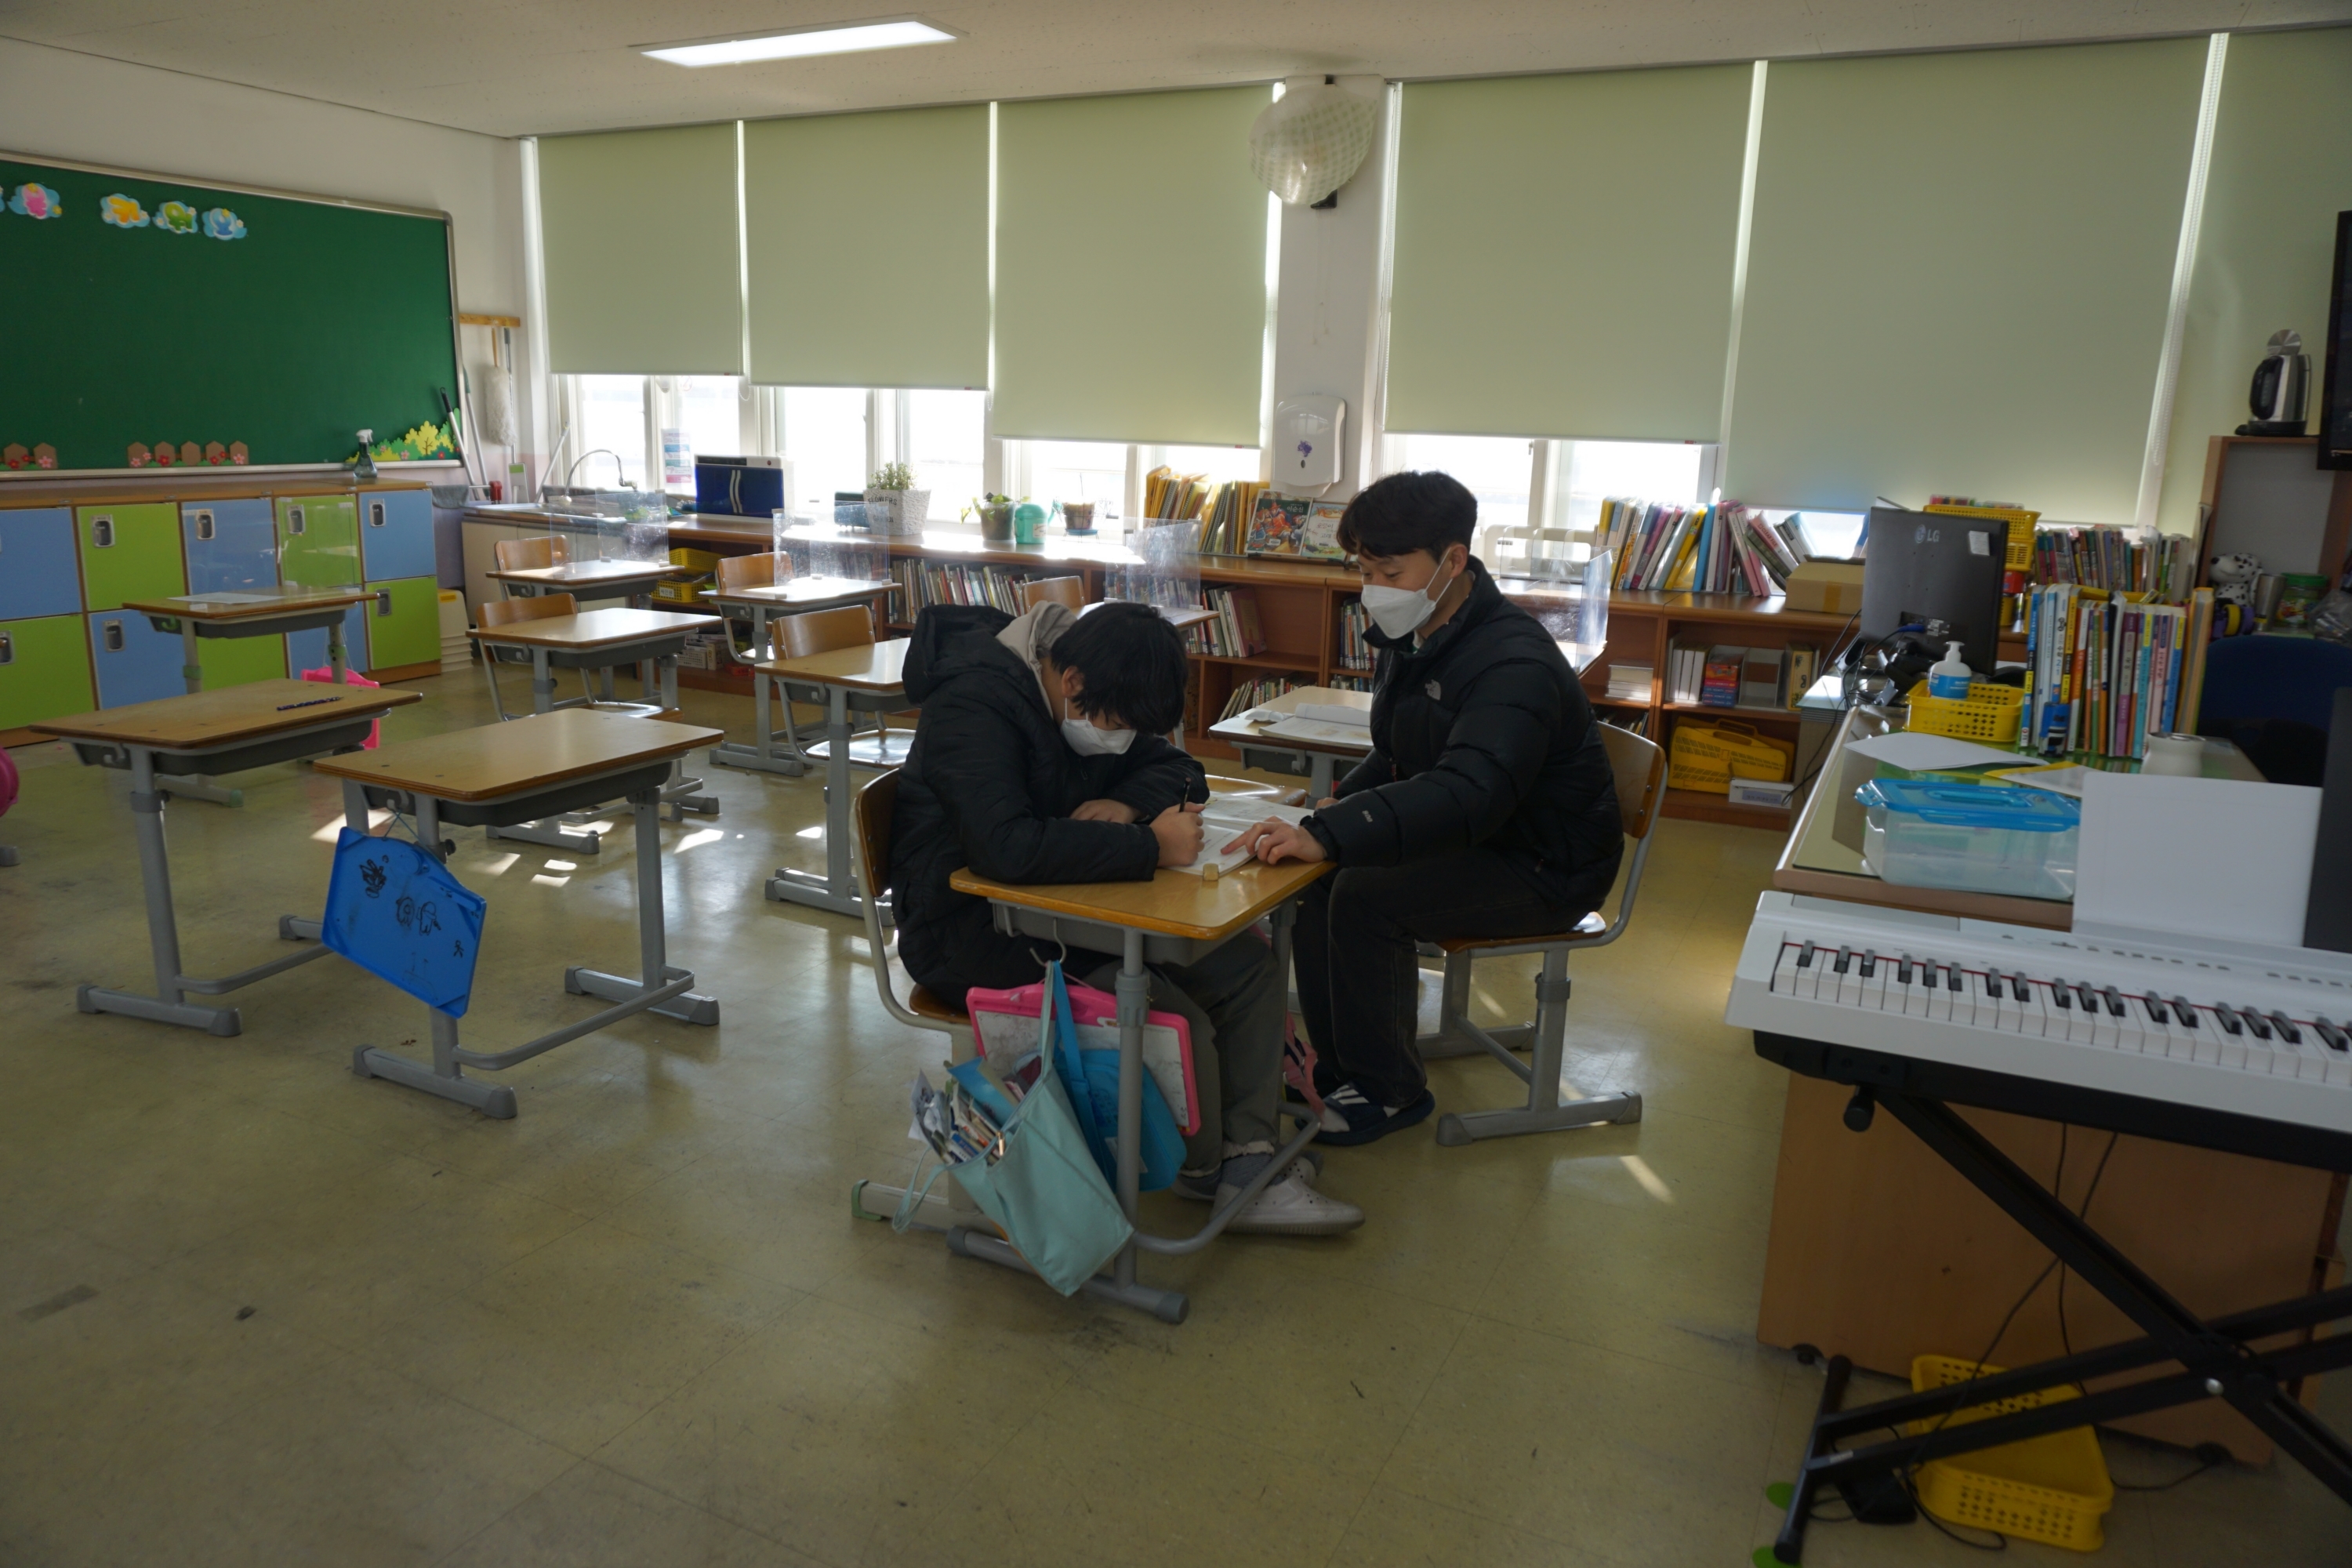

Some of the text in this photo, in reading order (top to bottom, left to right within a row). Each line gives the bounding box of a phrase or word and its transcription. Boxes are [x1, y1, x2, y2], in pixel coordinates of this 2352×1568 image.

[107, 195, 234, 240] 키워요
[1761, 527, 1772, 539] CLEAR
[1926, 528, 1940, 543] LG
